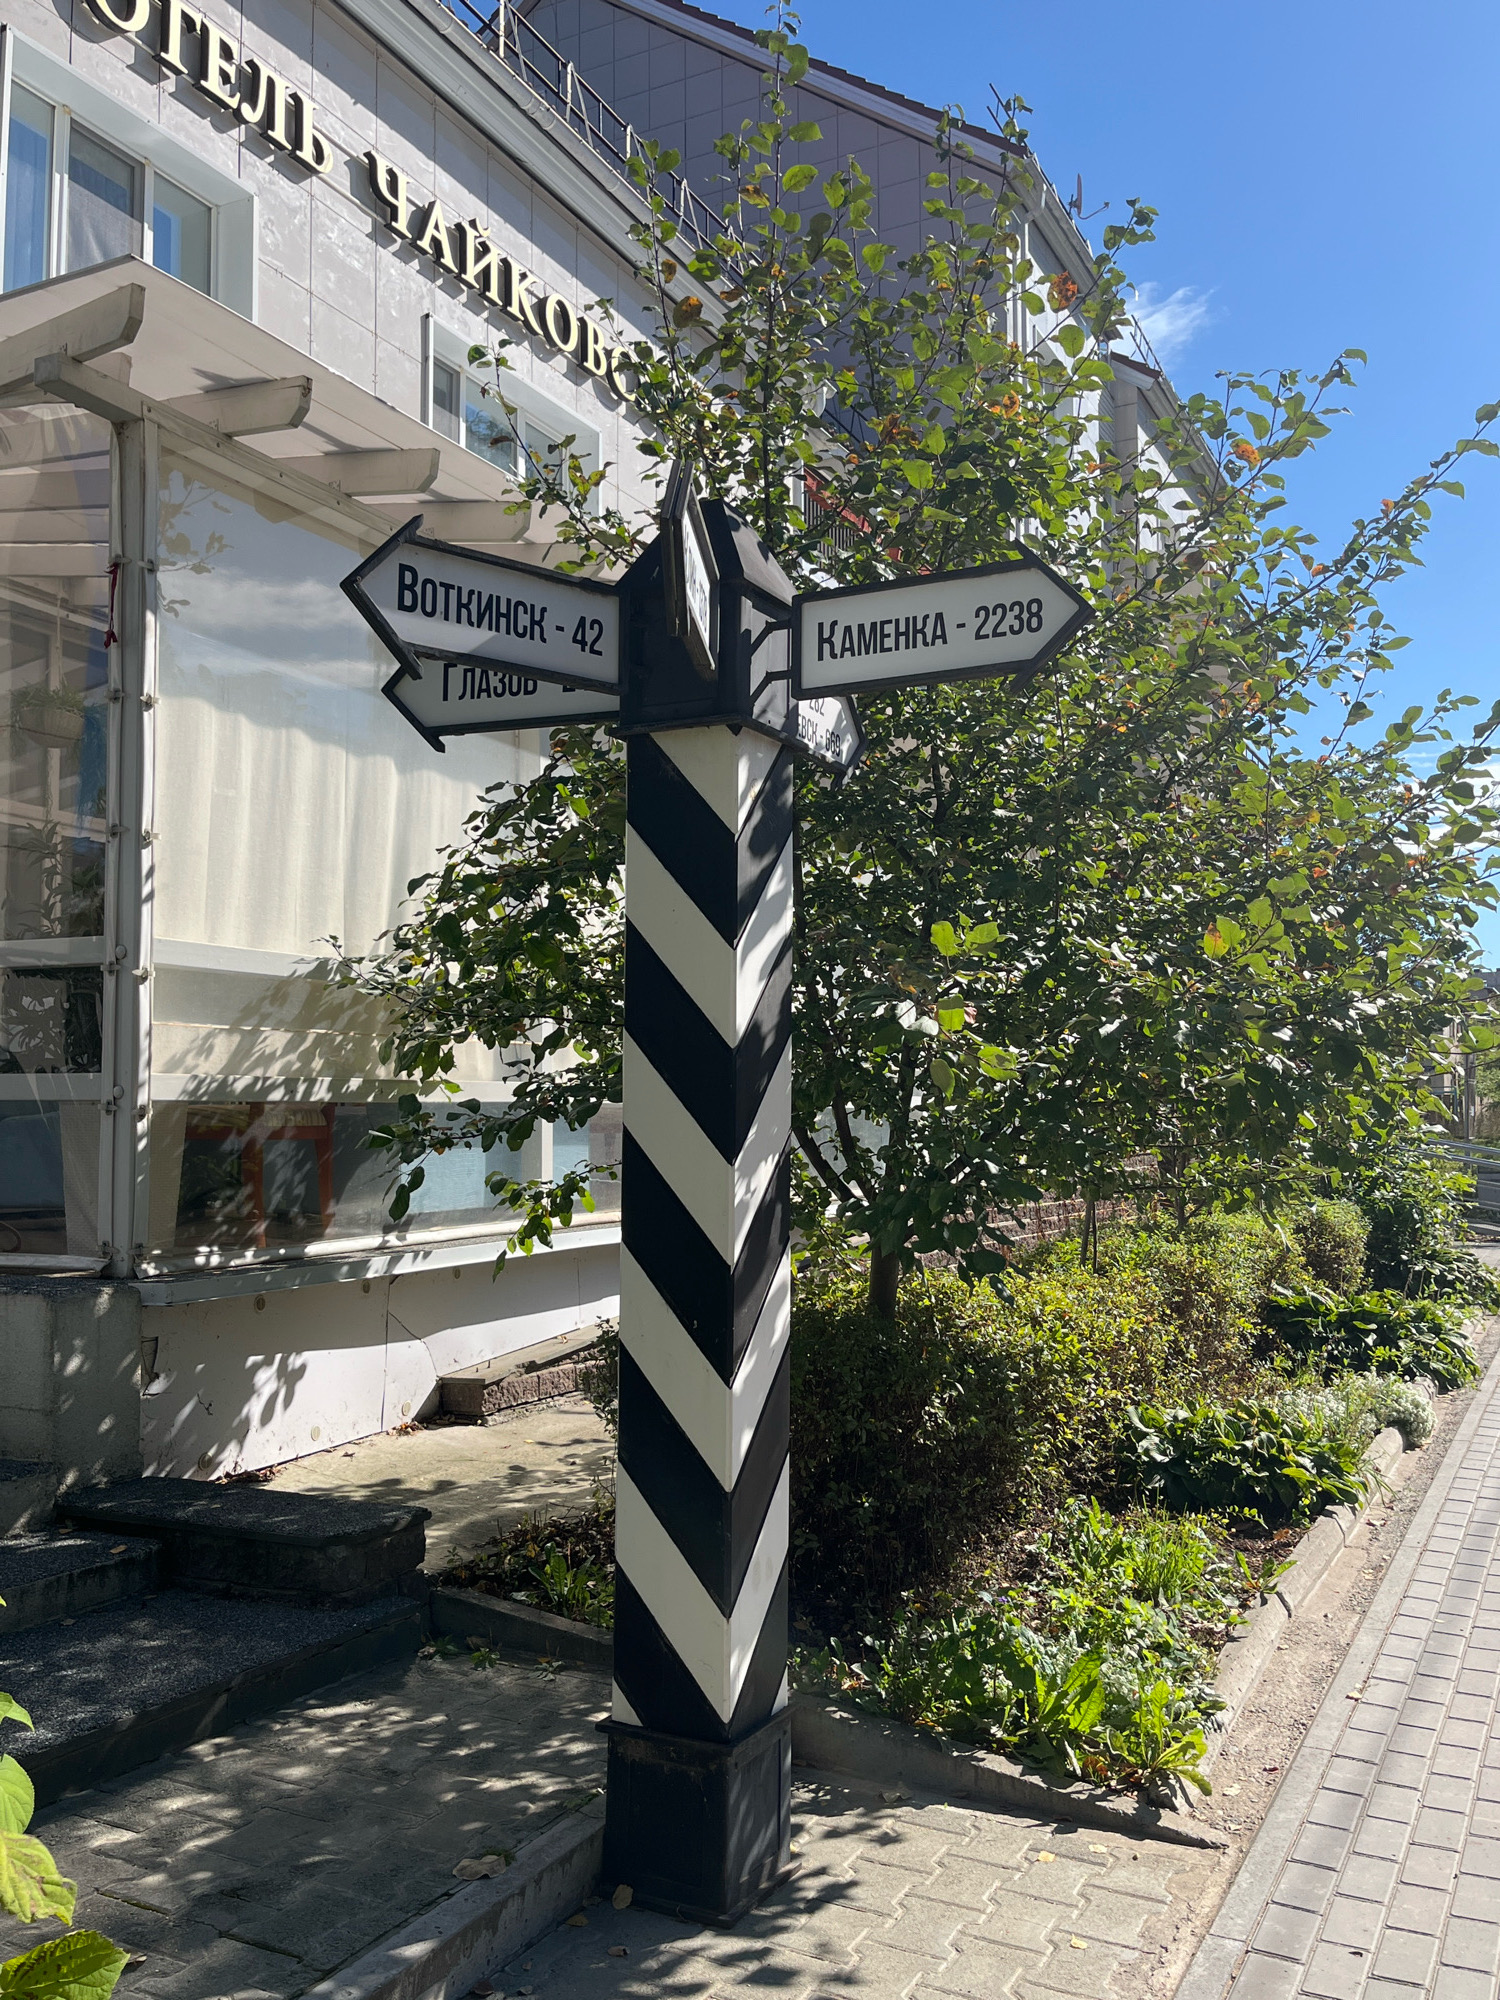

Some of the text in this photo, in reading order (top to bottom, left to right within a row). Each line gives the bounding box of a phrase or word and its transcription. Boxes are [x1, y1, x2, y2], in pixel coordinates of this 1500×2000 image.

[571, 615, 604, 657] 42
[974, 597, 1043, 641] 2238
[825, 728, 841, 757] 669
